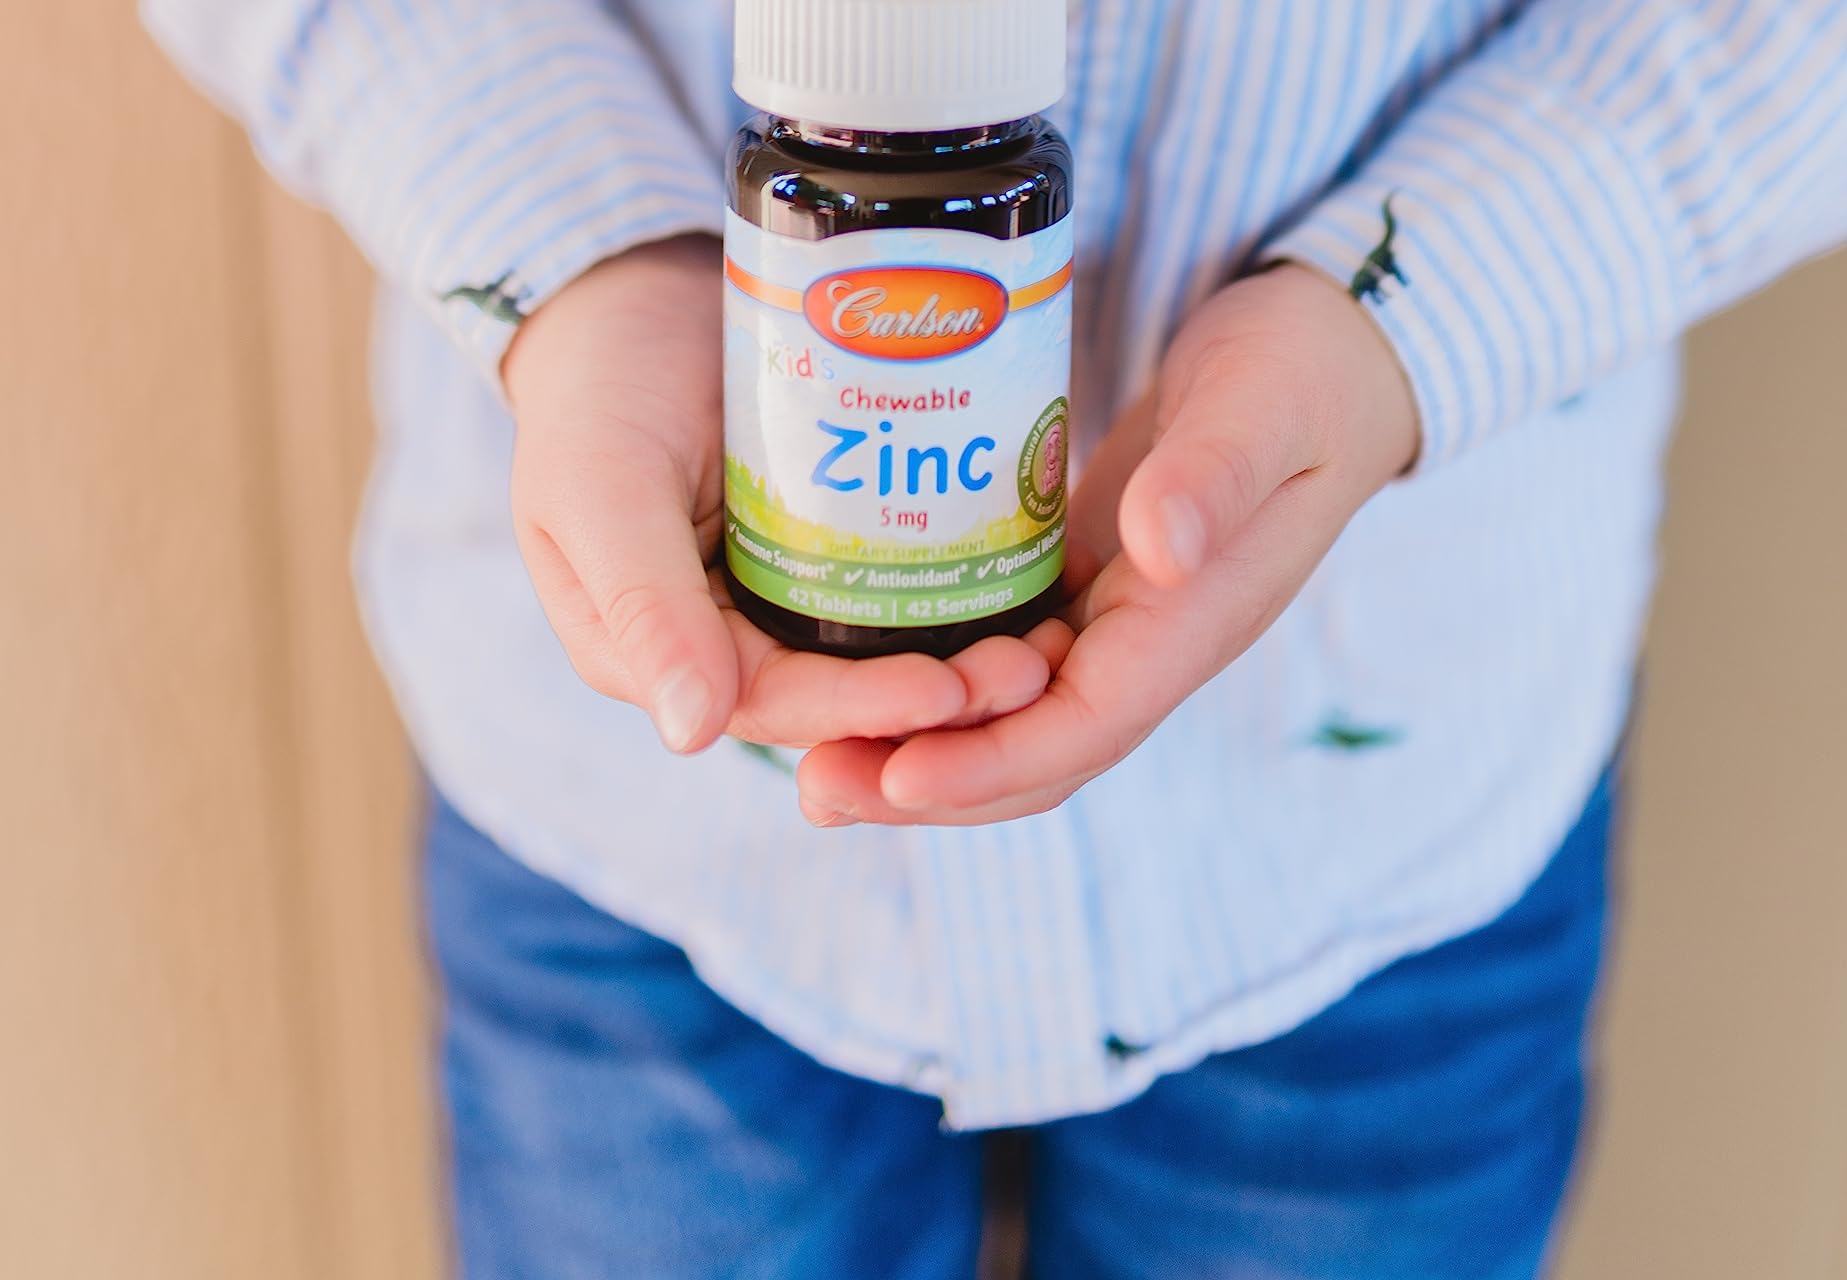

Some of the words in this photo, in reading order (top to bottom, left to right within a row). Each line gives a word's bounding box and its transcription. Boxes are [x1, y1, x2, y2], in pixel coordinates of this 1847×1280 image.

[827, 280, 985, 339] Carlson
[840, 387, 971, 412] Chewable
[811, 419, 996, 497] Zinc
[880, 507, 891, 527] 5
[897, 511, 929, 532] mg
[996, 540, 1041, 577] Optimal
[788, 587, 809, 605] 42
[813, 592, 881, 618] Tablets
[906, 600, 932, 618] 42
[936, 587, 1014, 617] Servings
